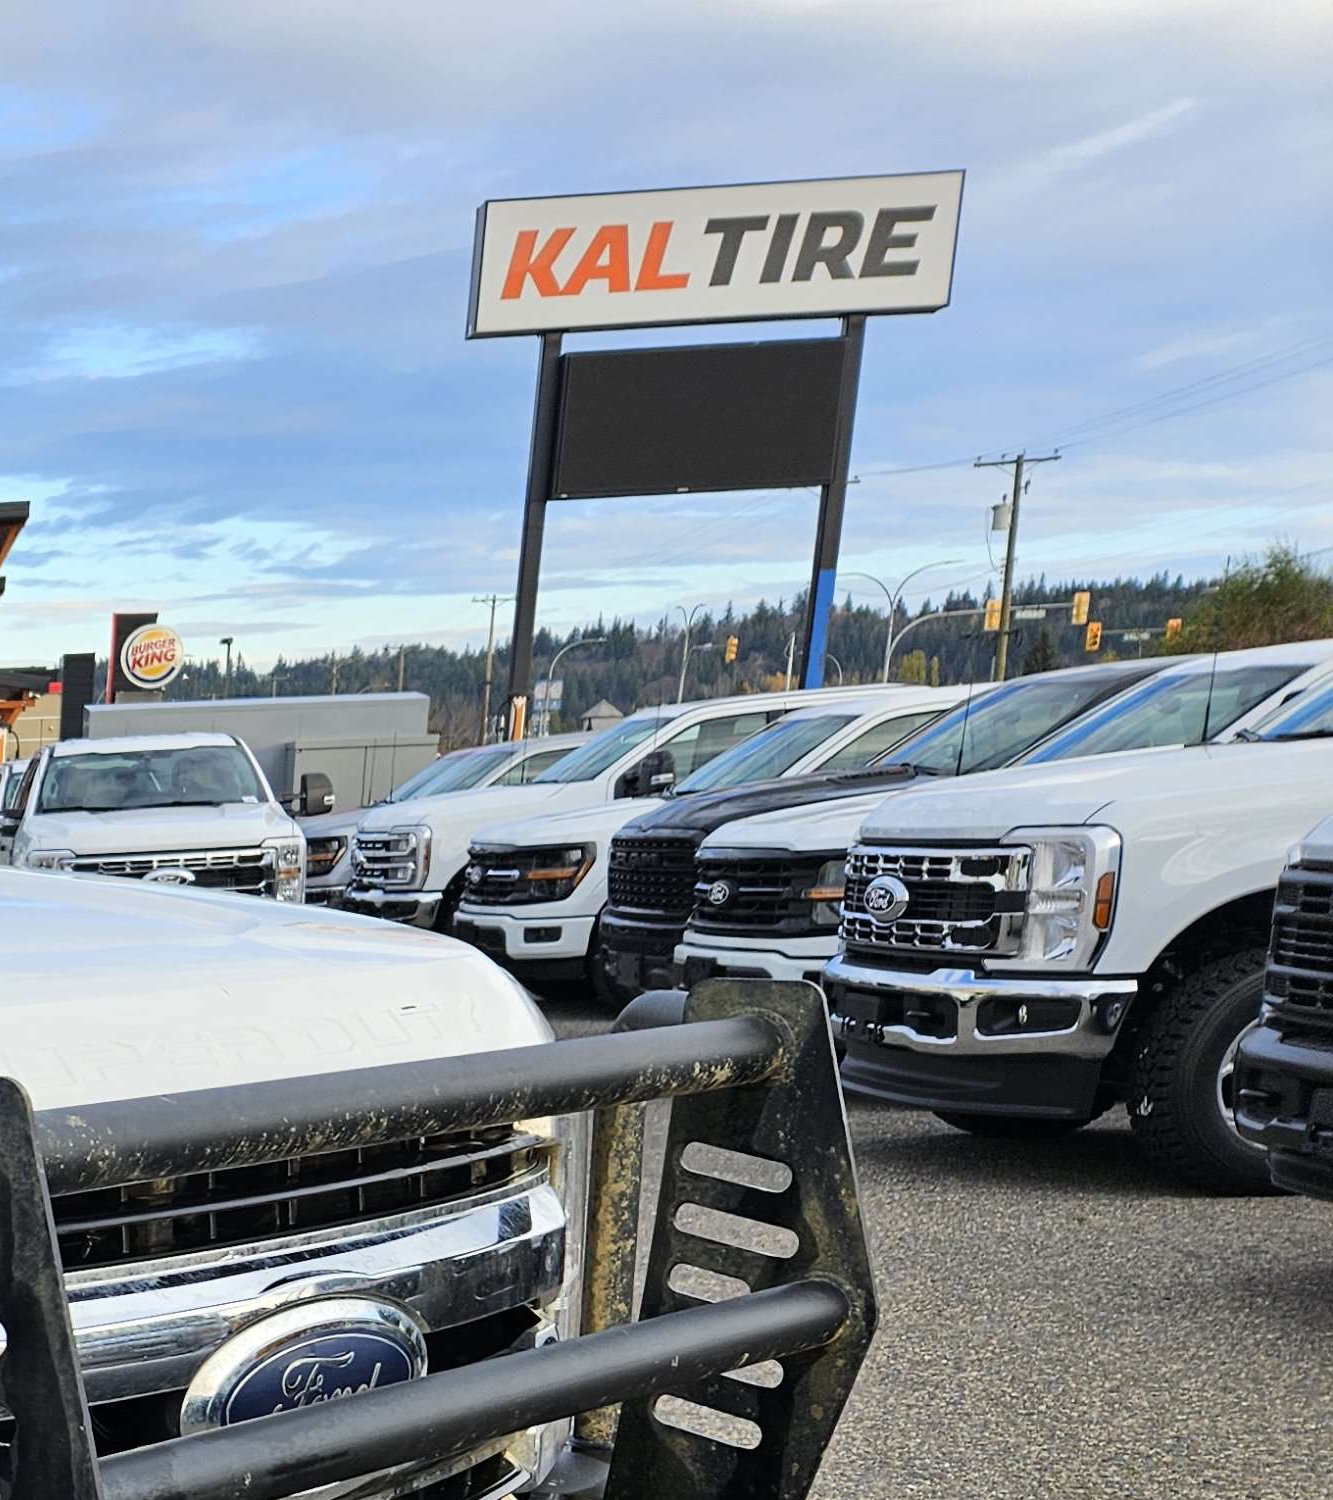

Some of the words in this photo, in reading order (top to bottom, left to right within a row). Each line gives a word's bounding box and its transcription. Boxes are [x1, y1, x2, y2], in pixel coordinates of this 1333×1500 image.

[500, 220, 691, 300] KAL
[704, 203, 938, 287] TIRE
[131, 637, 176, 656] BURGER
[131, 648, 176, 672] KING
